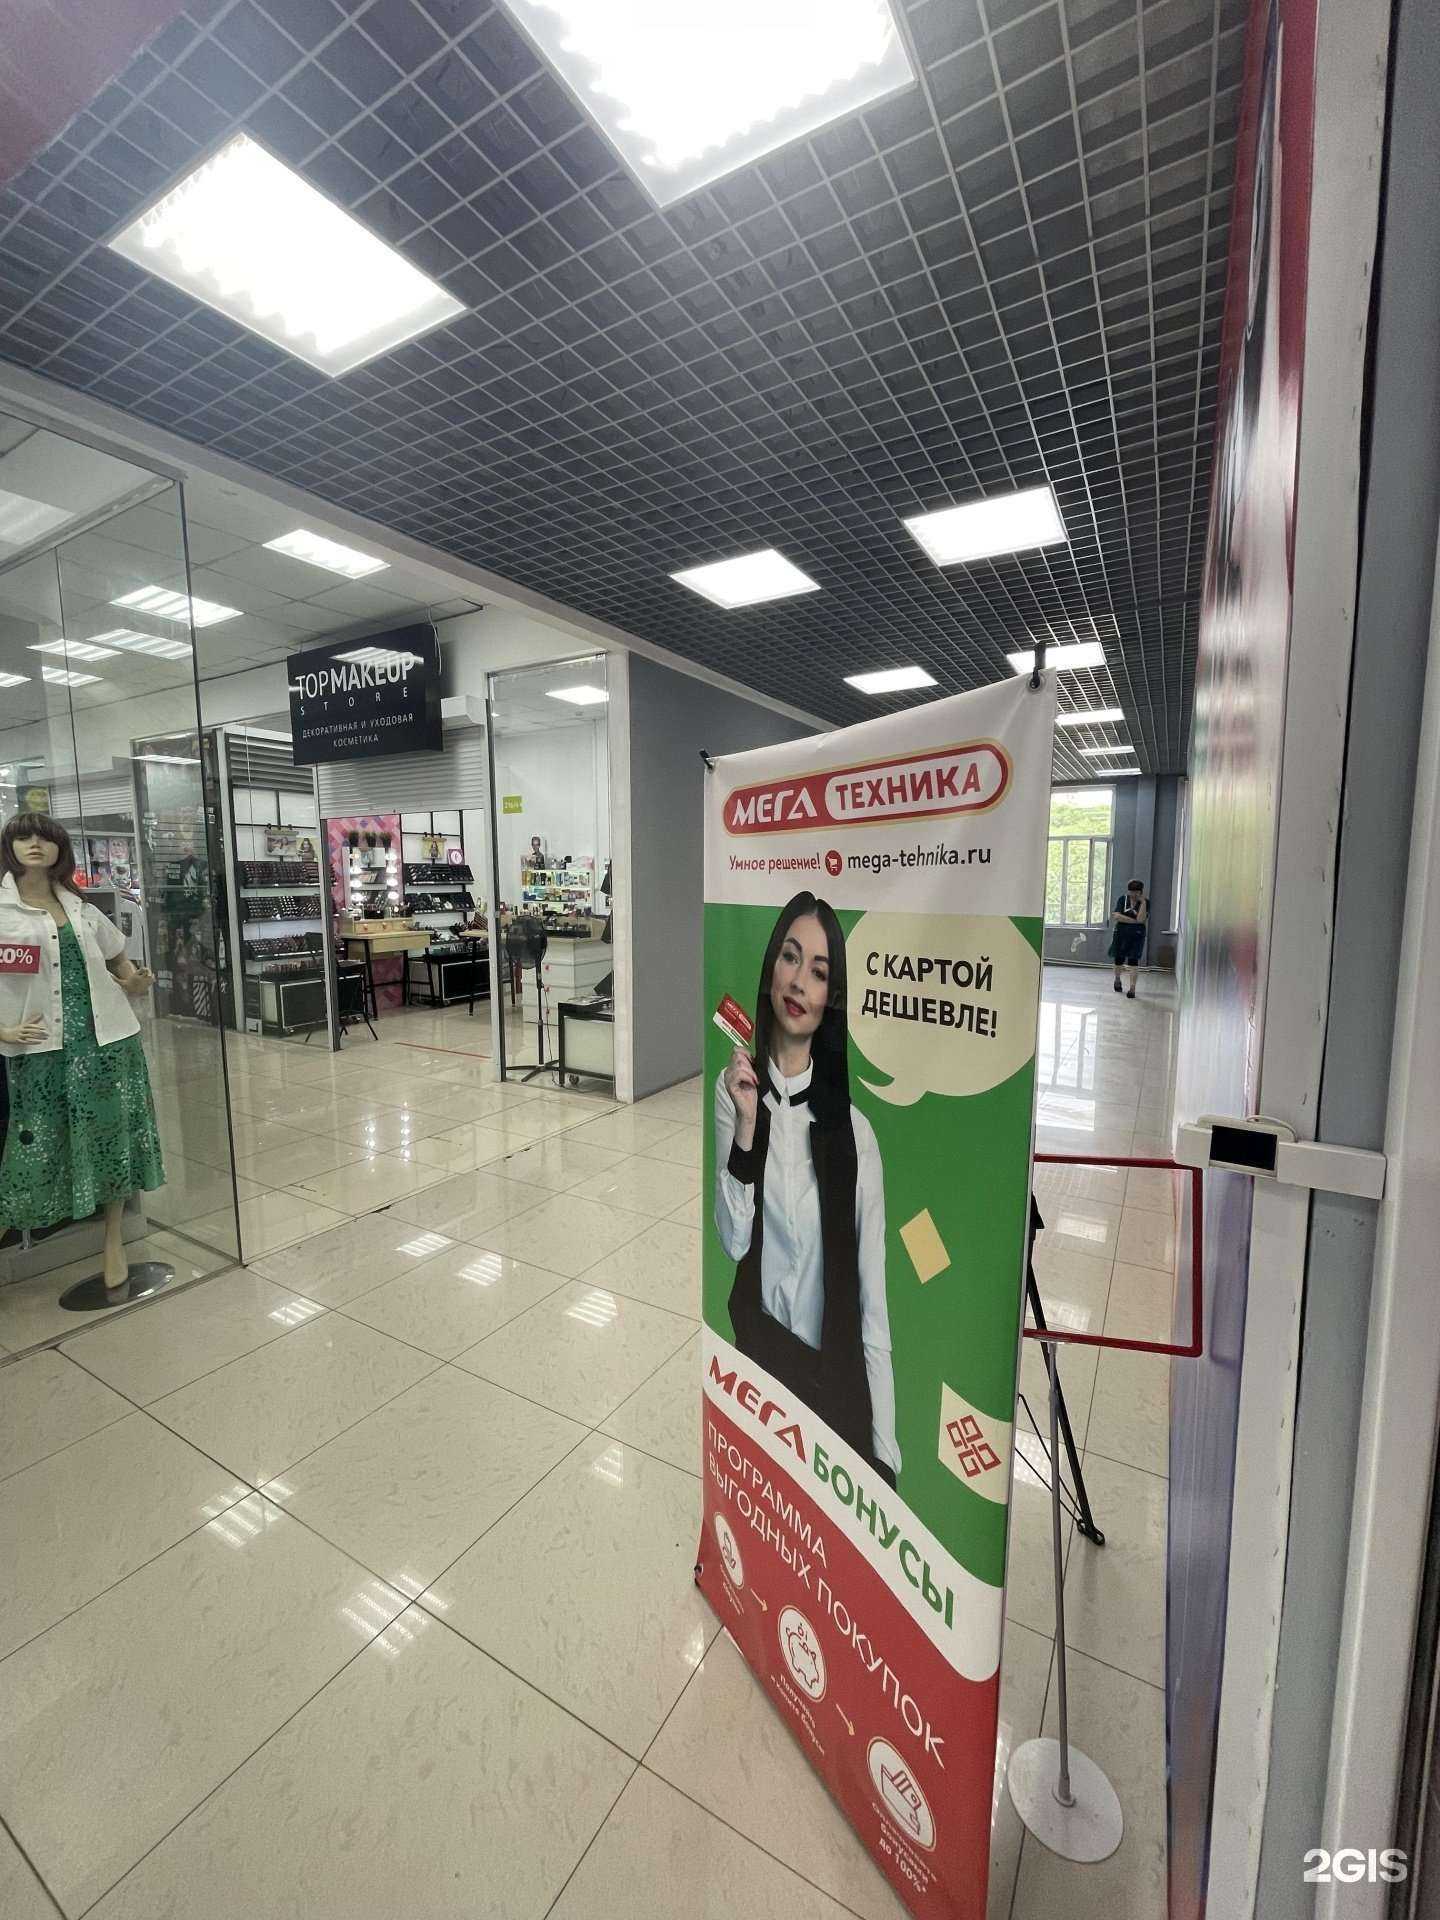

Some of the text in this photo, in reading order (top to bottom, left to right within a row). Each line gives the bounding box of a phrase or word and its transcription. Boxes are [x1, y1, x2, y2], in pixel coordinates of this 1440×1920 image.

[295, 653, 414, 700] TOPMAKEUP
[300, 686, 408, 716] STORE
[302, 712, 414, 739] ДЕКОРАТИВНАЯ И УХОДОВАЯ
[333, 734, 379, 748] КОСМЕТИКА
[731, 762, 982, 827] МЕГА ТЕХНИКА
[728, 851, 822, 875] Умное решение!
[847, 842, 992, 874] mega-tehnika.ru
[0, 947, 33, 965] 0%
[866, 951, 993, 992] С КАРТОЙ
[861, 988, 998, 1038] ДЕШЕВЛЕ!
[707, 1420, 828, 1568] ПРОГРАММА
[708, 1354, 954, 1630] МЕГА БОНУСЫ
[708, 1451, 812, 1590] ВЫГОДНЫХ
[817, 1577, 945, 1770] ПОКУПОК
